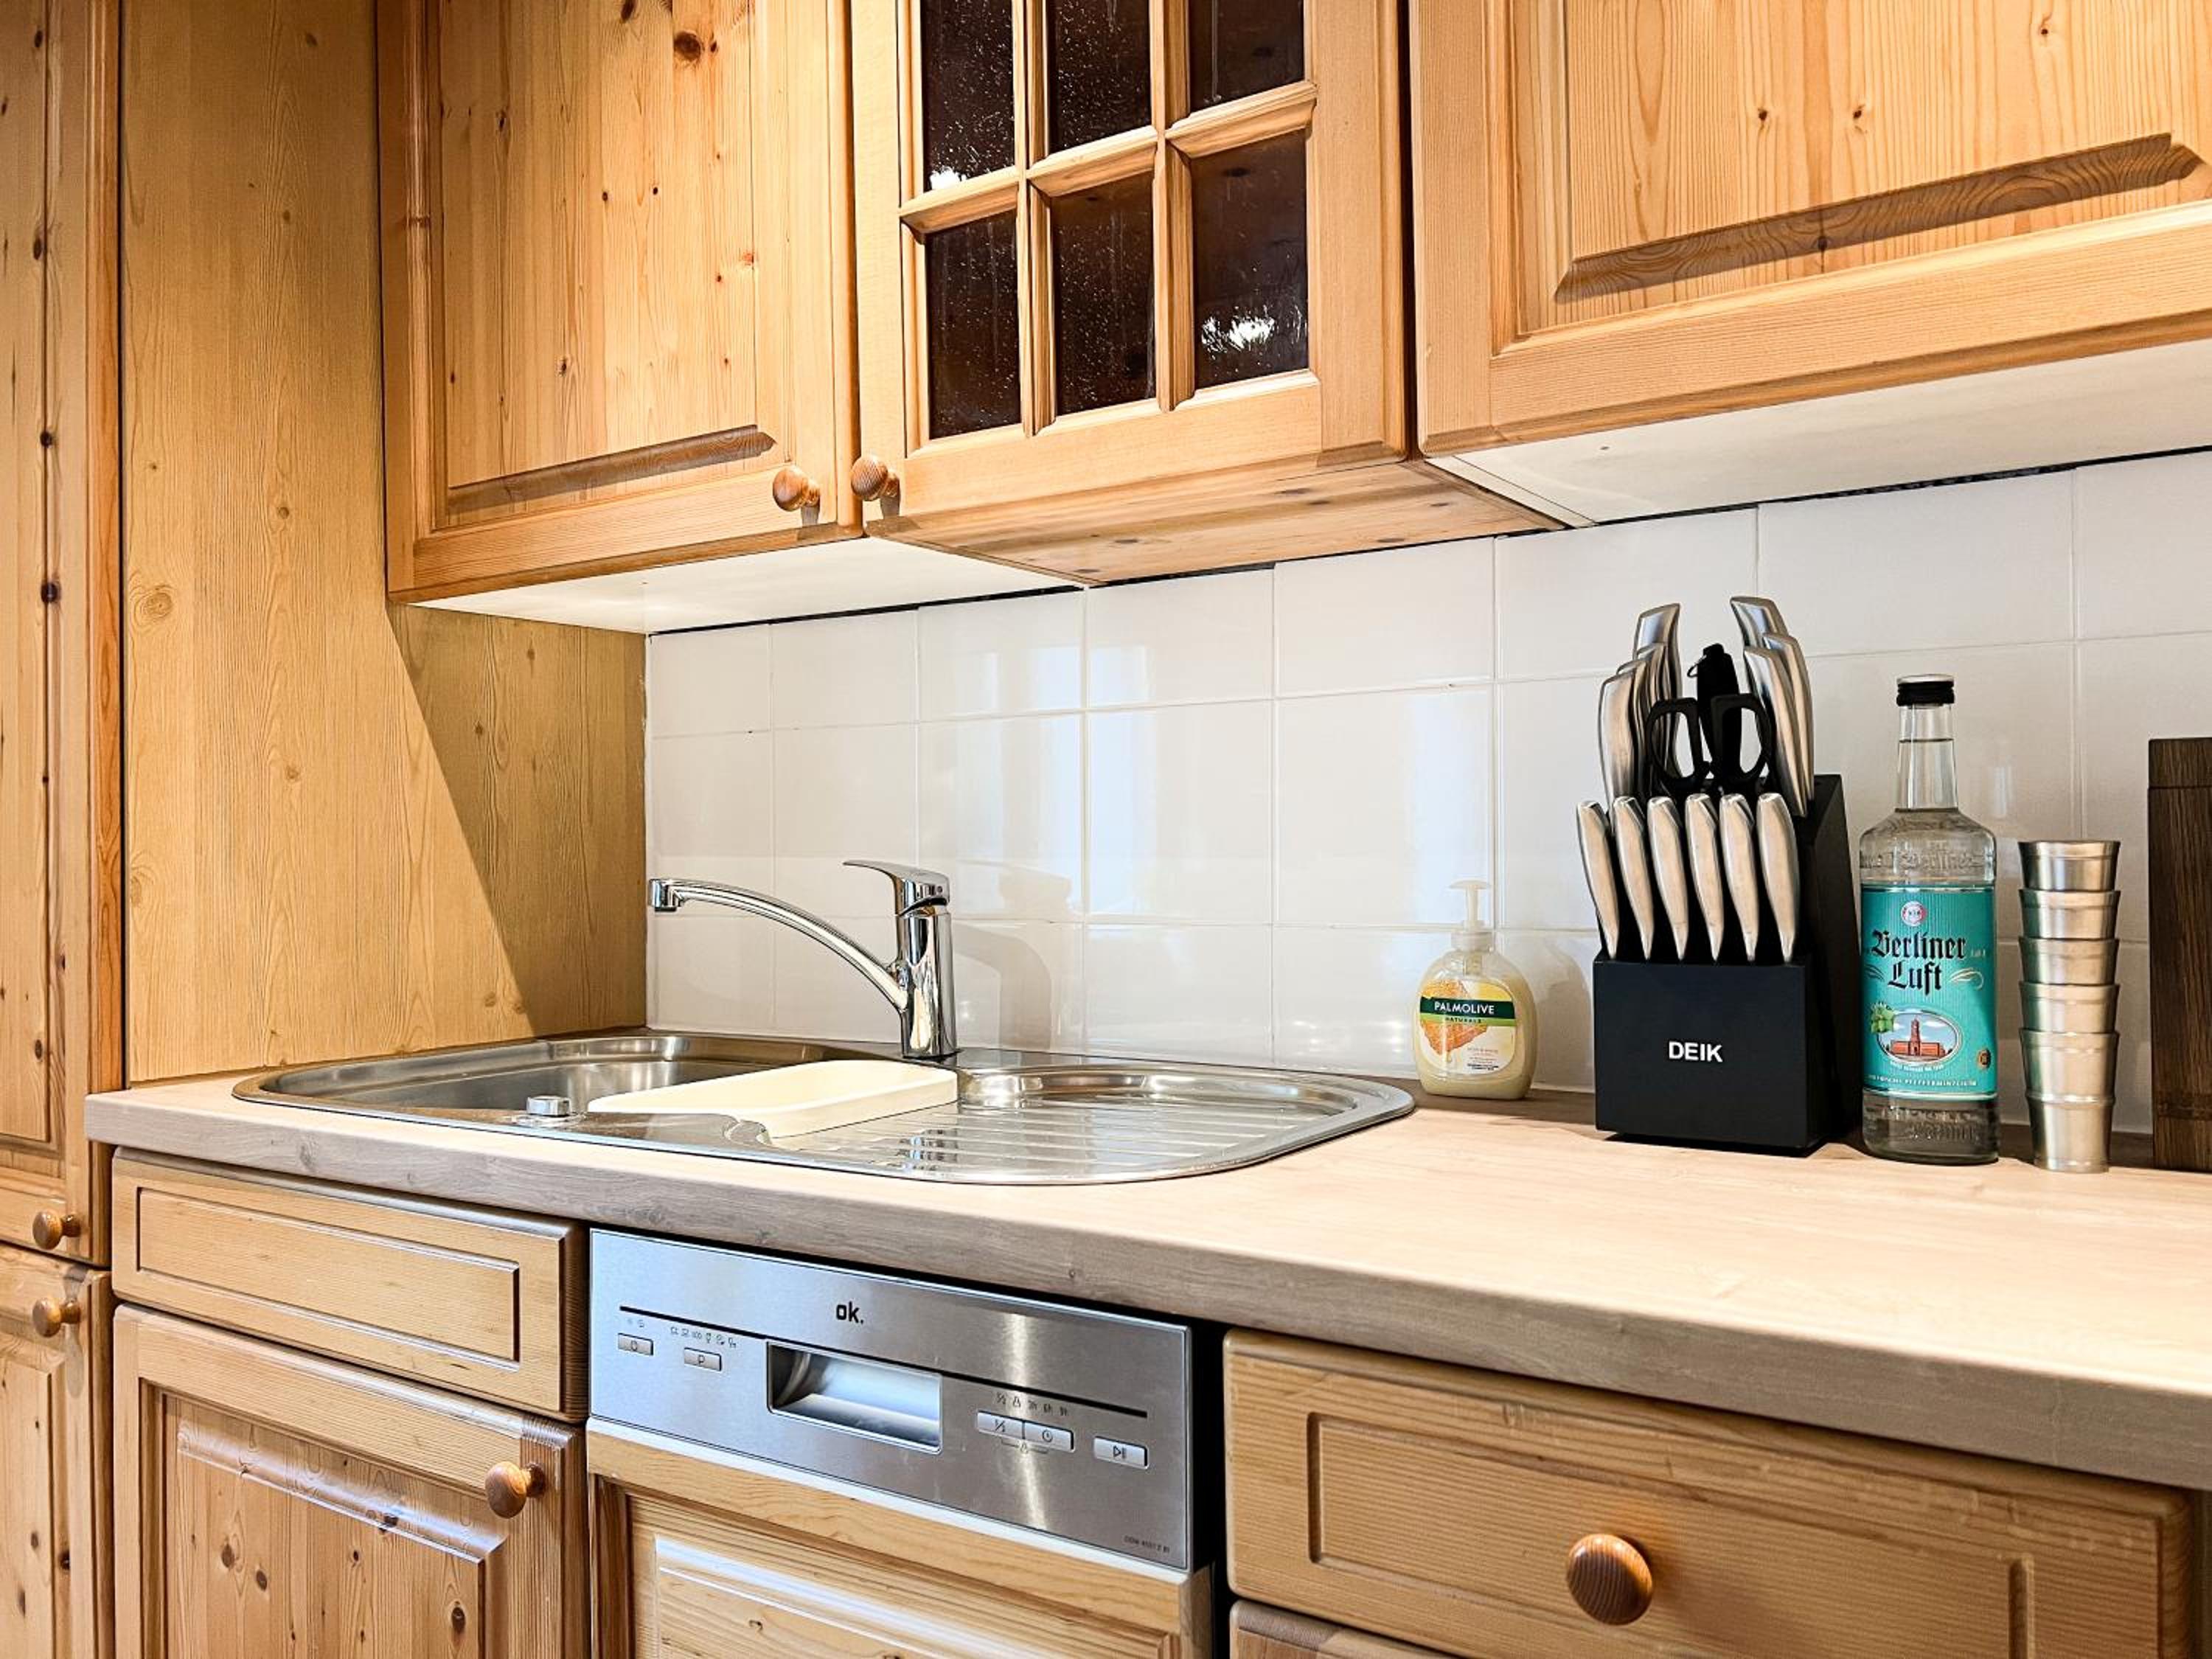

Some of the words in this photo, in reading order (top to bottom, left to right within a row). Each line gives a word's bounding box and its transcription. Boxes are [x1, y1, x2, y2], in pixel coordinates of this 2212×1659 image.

[1871, 928, 1966, 959] Berliner
[1888, 960, 1942, 996] Luft
[1434, 1001, 1495, 1015] PALMOLIVE
[1669, 1040, 1723, 1062] DEIK
[835, 1301, 864, 1325] ok.
